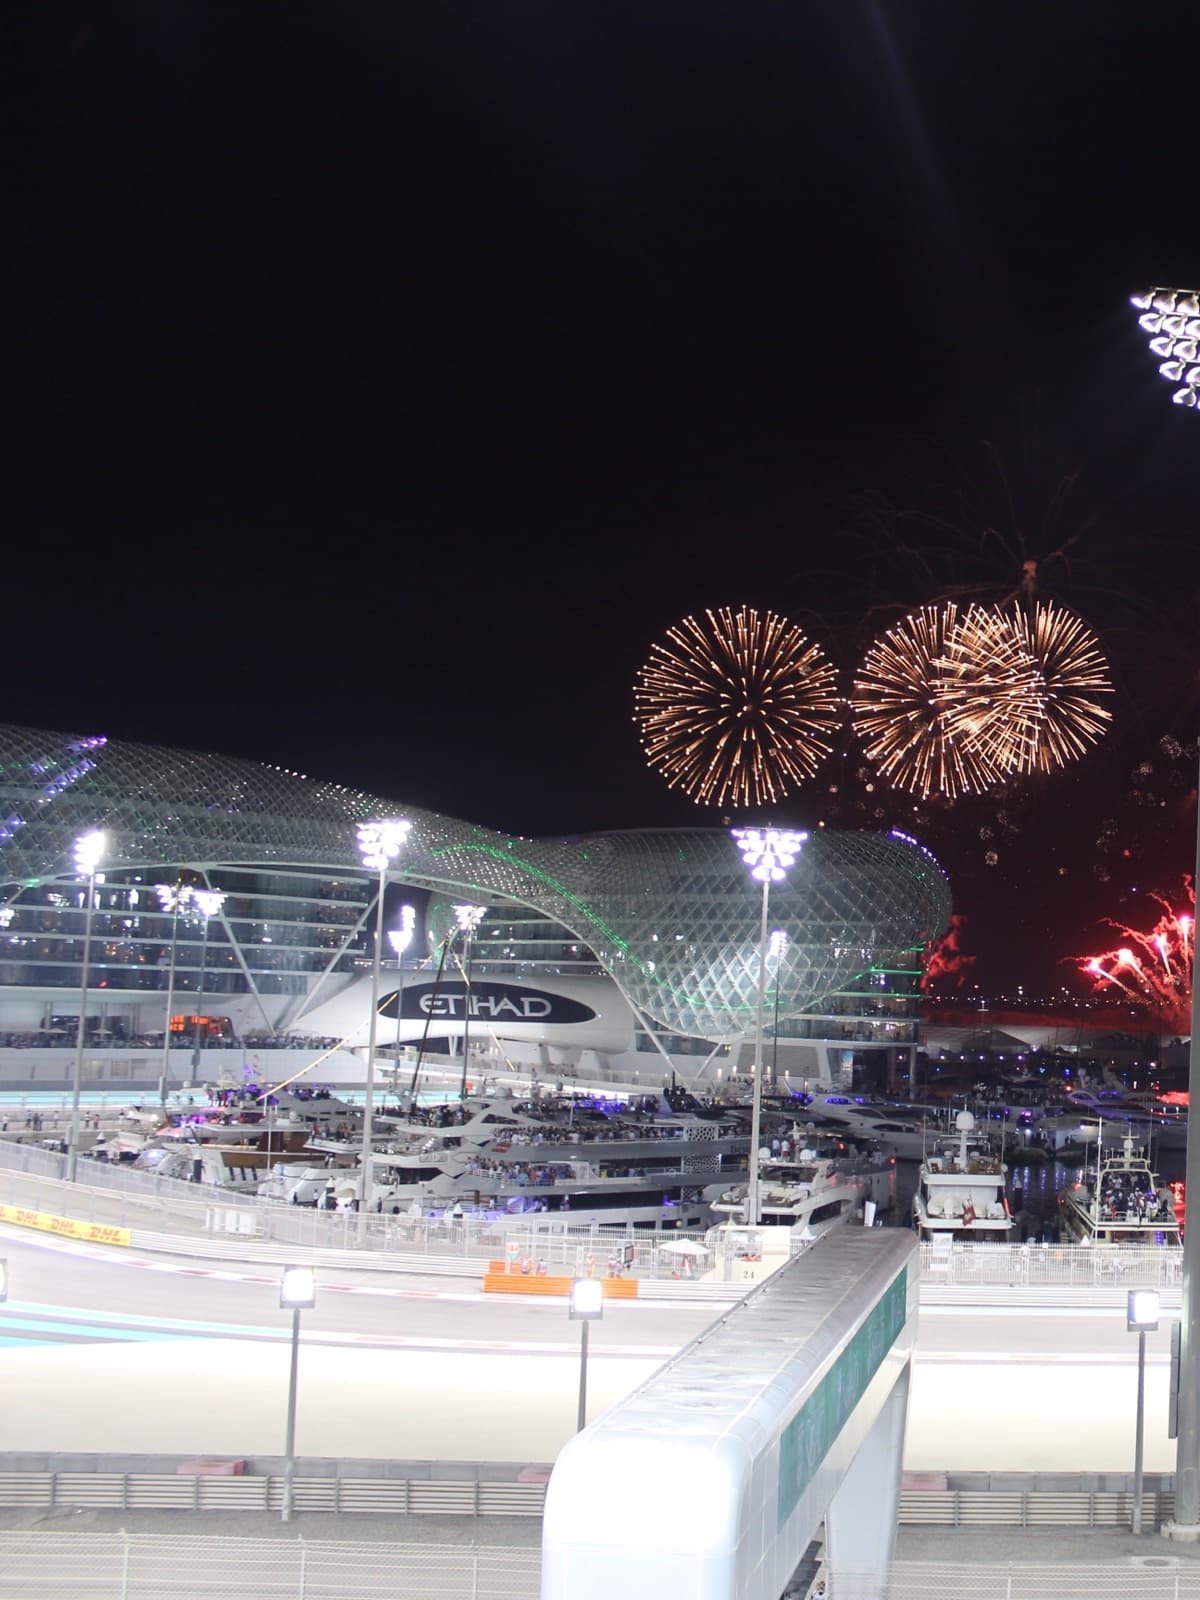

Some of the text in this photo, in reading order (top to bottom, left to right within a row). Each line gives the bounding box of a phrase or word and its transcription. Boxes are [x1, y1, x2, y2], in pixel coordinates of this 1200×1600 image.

[419, 993, 552, 1017] ETIHAD
[51, 1218, 76, 1234] DHL
[89, 1226, 121, 1242] DHL
